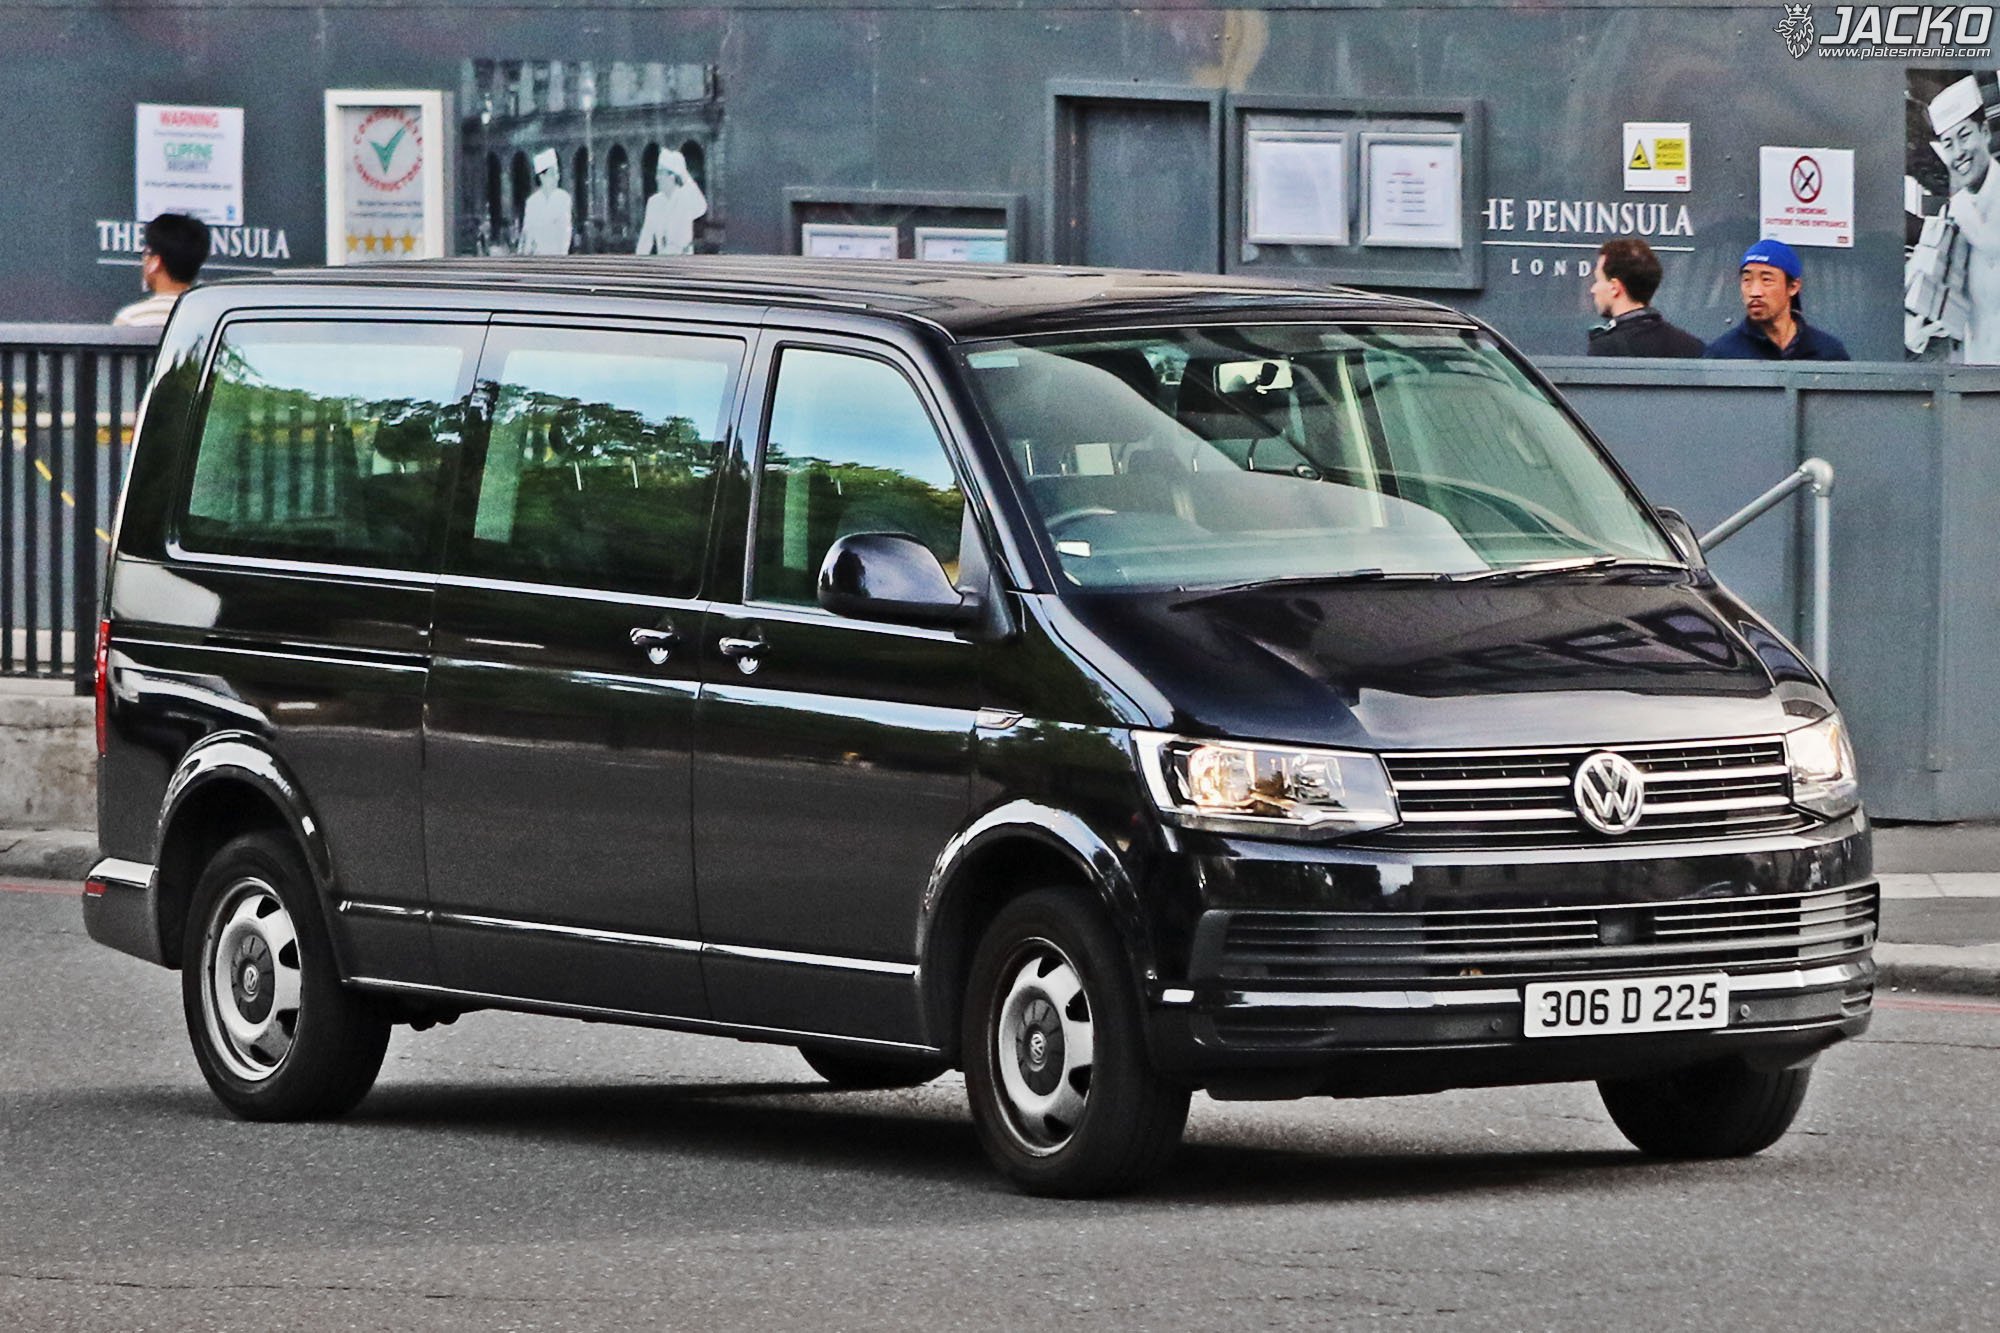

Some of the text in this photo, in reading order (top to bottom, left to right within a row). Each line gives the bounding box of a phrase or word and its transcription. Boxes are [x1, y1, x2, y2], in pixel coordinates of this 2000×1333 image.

[160, 111, 219, 128] WARNING
[1481, 198, 1695, 237] HE PENINSULA
[96, 220, 291, 260] THE NSULA
[1511, 258, 1592, 278] LOND
[1541, 982, 1718, 1027] 306 D 225
